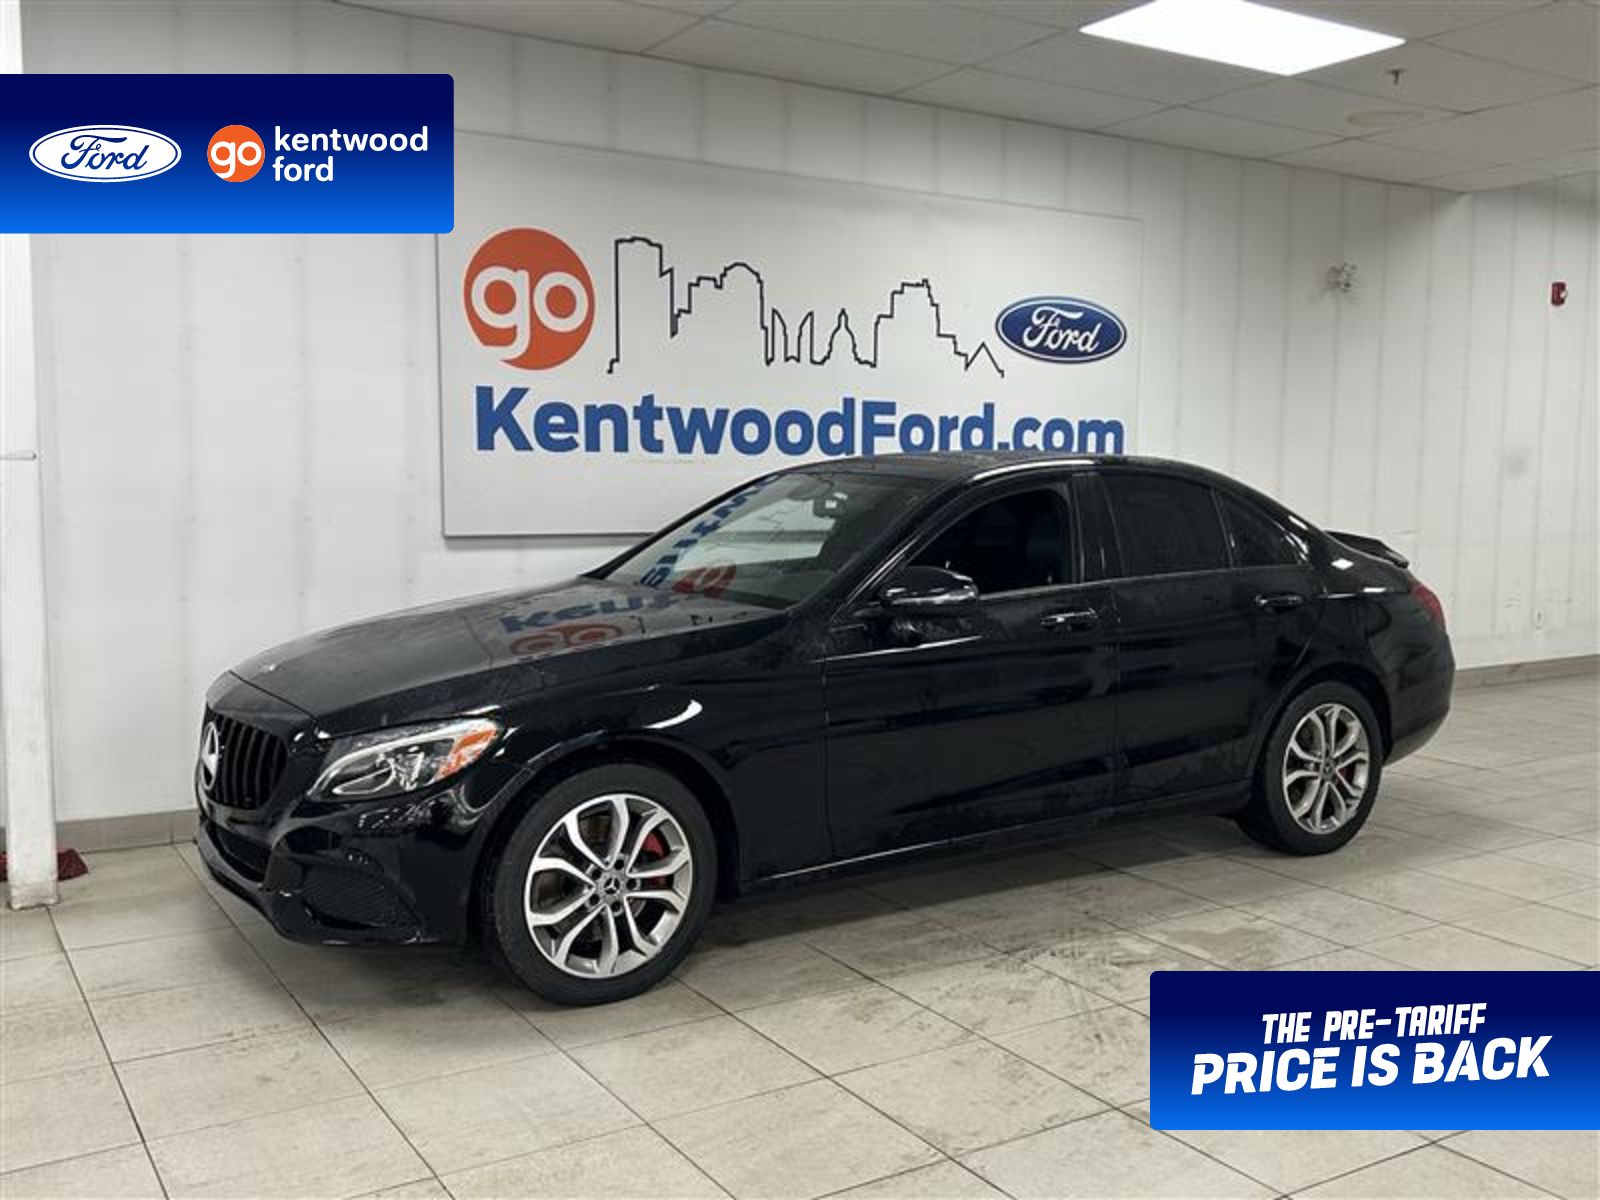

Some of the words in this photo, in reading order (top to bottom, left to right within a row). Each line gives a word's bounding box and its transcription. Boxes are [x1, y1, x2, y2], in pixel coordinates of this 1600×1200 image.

[470, 265, 589, 361] go
[1022, 305, 1102, 353] Ford
[475, 385, 1125, 456] KentwoodFord.com
